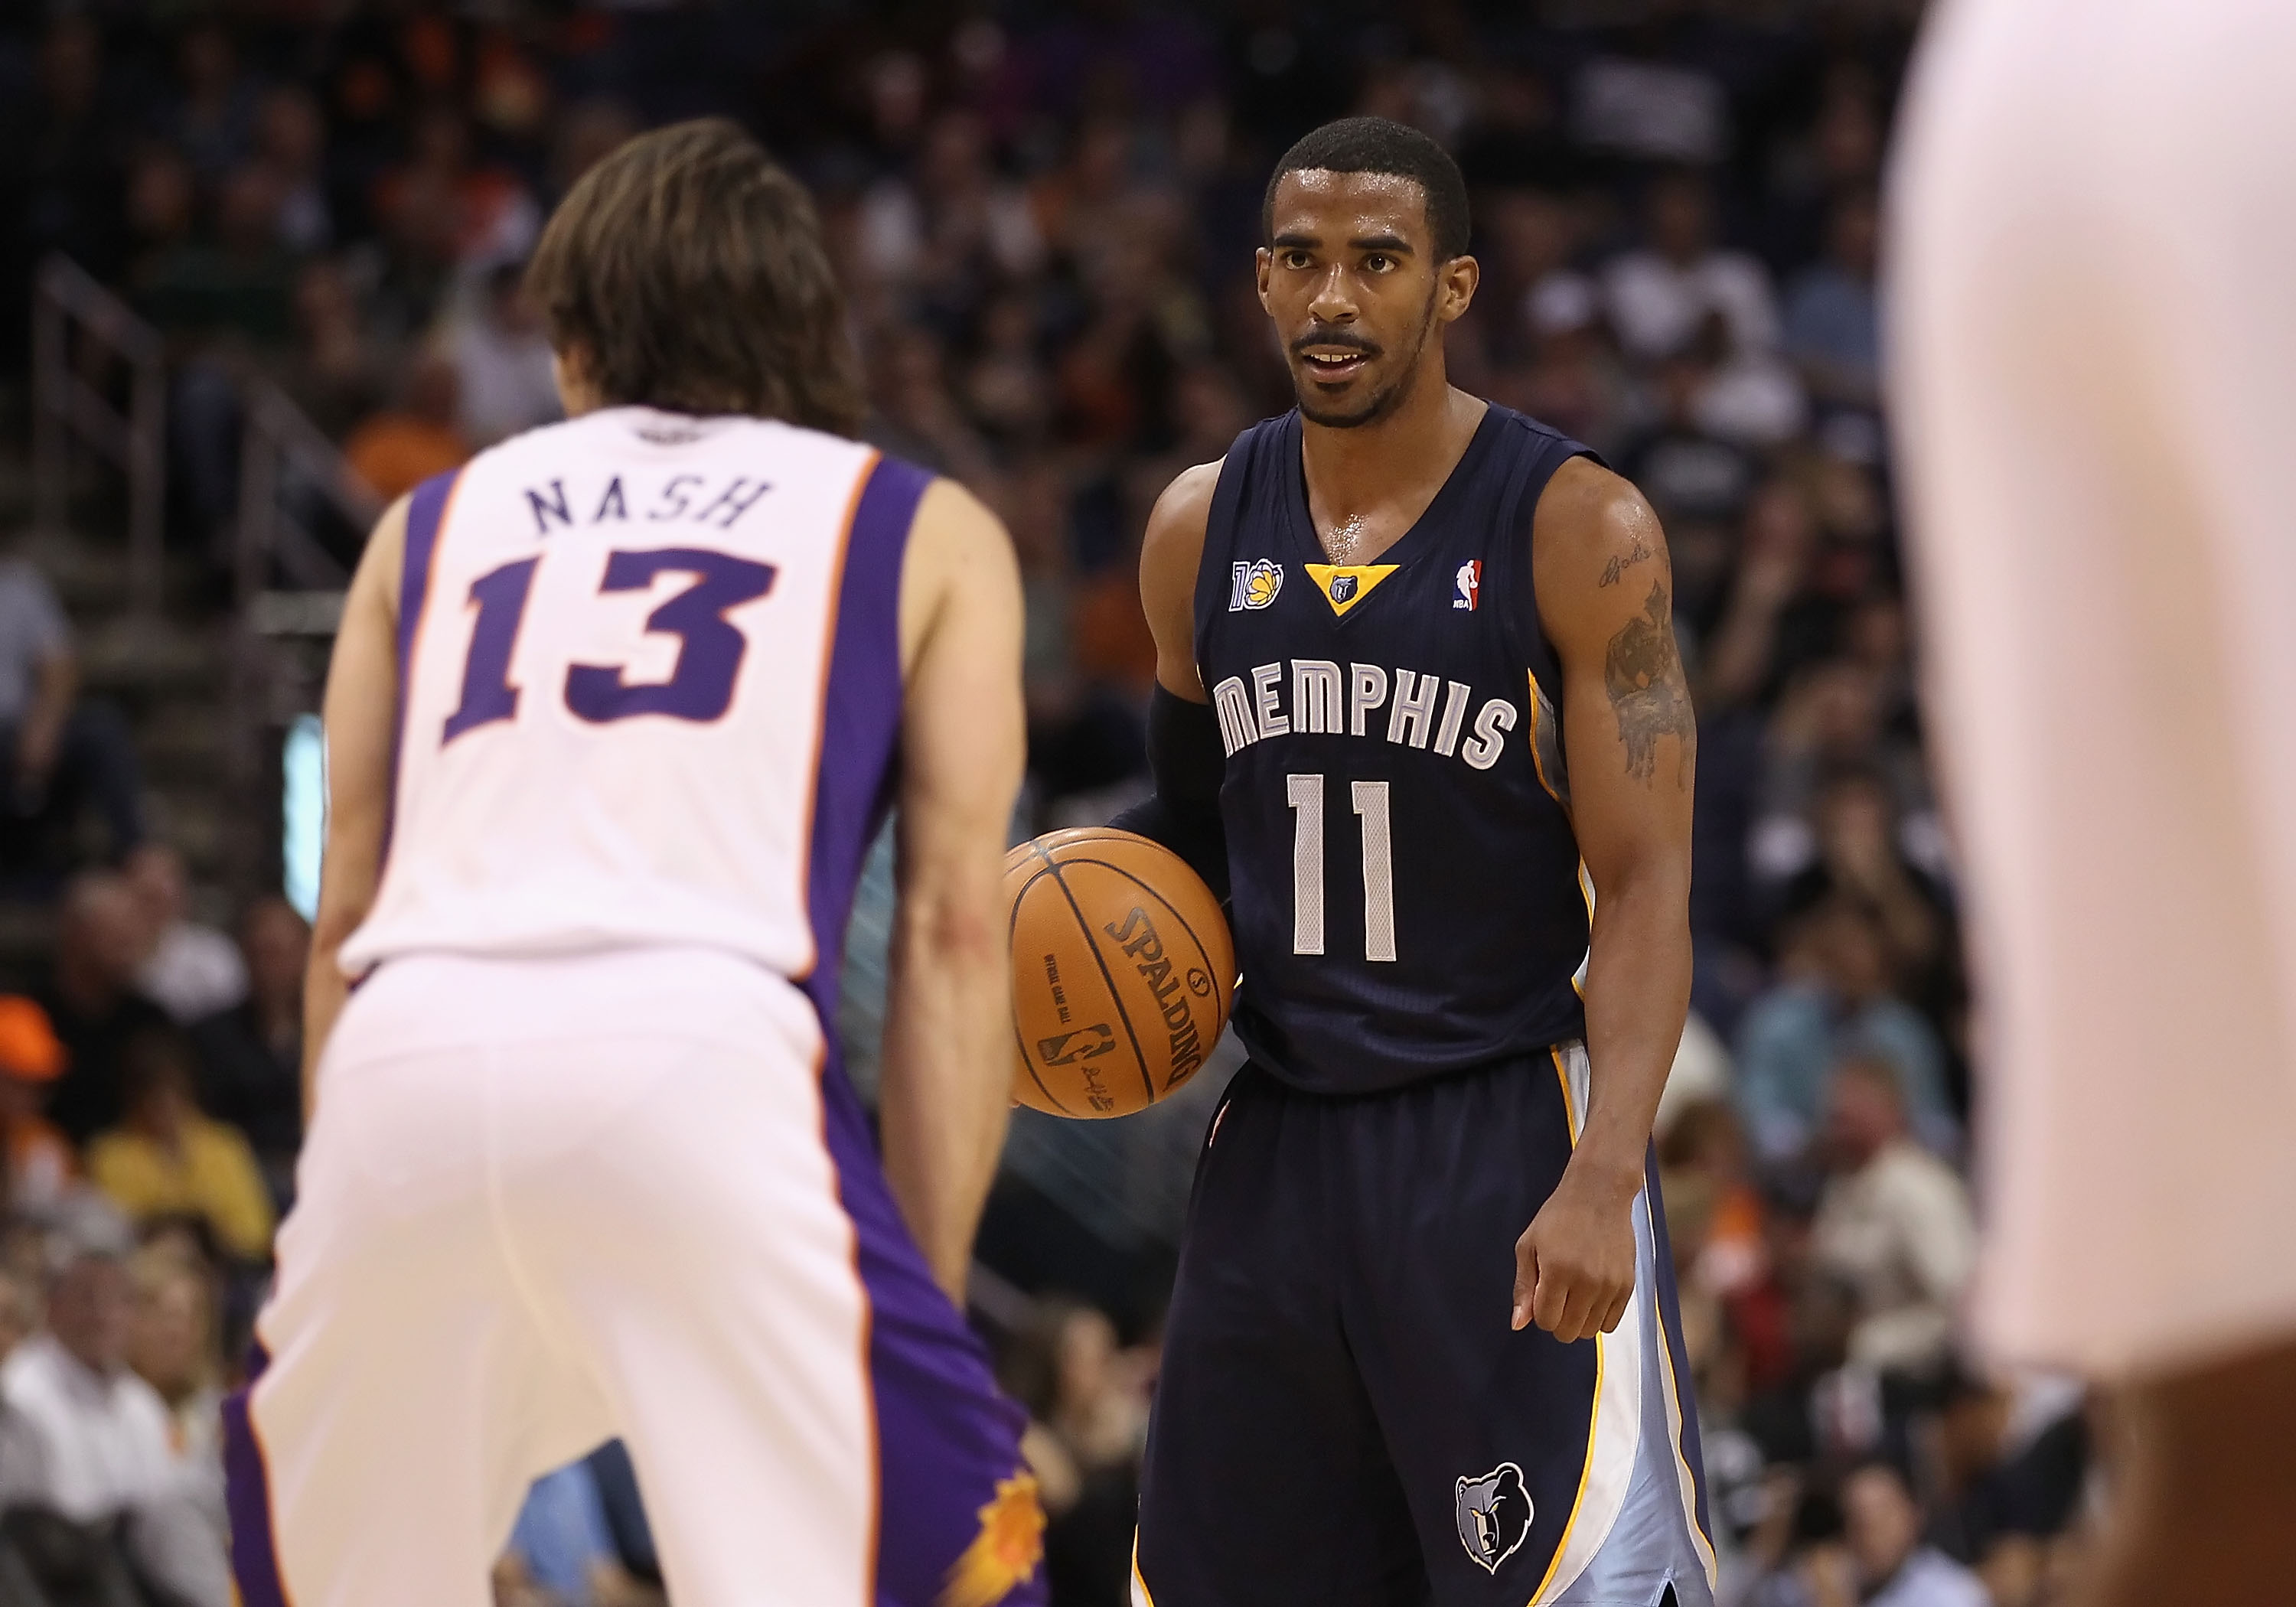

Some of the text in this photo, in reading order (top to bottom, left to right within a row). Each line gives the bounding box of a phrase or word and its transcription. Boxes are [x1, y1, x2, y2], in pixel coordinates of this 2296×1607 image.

[523, 474, 775, 535] NASH
[440, 547, 778, 748] 13
[1453, 599, 1469, 609] NBA
[1213, 659, 1518, 771] MEMPHIS
[1287, 774, 1397, 962] 11
[1103, 906, 1202, 1091] SPALDING
